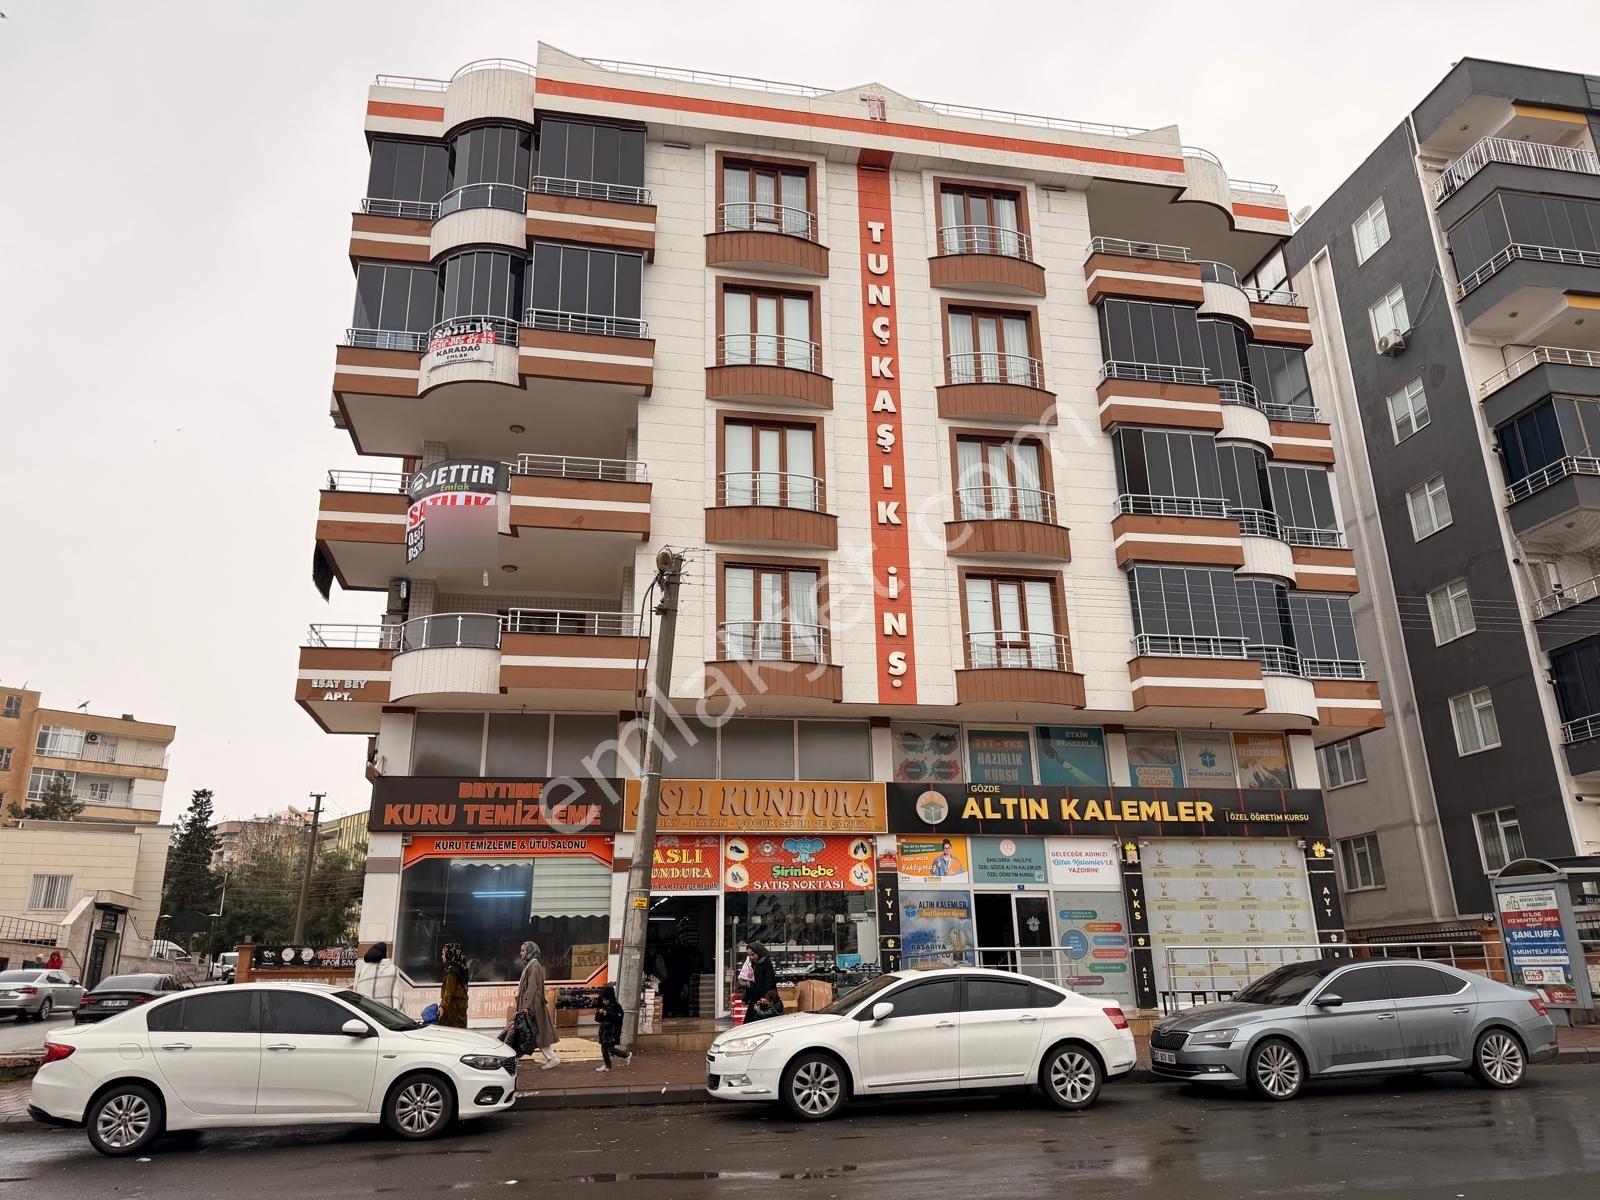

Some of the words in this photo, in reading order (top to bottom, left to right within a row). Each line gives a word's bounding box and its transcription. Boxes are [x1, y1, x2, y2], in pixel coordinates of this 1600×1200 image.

[433, 322, 494, 339] SATILIK
[436, 344, 481, 357] KARADAĞ
[867, 221, 901, 525] TUNÇKAŞIK
[440, 482, 470, 492] Emlak
[311, 679, 341, 688] ESAT
[344, 679, 368, 689] BEY
[323, 691, 353, 701] APT.
[1057, 740, 1099, 748] REHBERLİK
[977, 752, 1023, 766] HAZIRLIK
[984, 768, 1019, 781] KURSU
[971, 784, 1000, 794] GÖZDE
[631, 786, 713, 818] SLI
[720, 786, 876, 818] KUNDURA
[383, 803, 457, 826] KURU
[463, 799, 602, 826] TEMİZLEME
[961, 797, 1050, 820] ALTIN
[1060, 798, 1215, 823] KALEMLER
[1229, 812, 1249, 821] ÖZEL
[1250, 811, 1283, 821] ÖĞRETİM
[1283, 814, 1310, 822] KURSU
[690, 819, 728, 828] BAYAN
[737, 819, 776, 830] ÇOCUK
[780, 820, 809, 829] SPOR
[813, 820, 828, 829] VE
[829, 820, 867, 831] ÇANTA
[434, 840, 462, 850] KURU
[464, 839, 518, 850] TEMİZLEME
[519, 840, 527, 850] &
[529, 838, 548, 850] ÜTÜ
[550, 840, 588, 850] SALONU
[771, 864, 835, 879] Şirinbebe
[753, 881, 792, 891] SATIŞ
[792, 881, 845, 890] NOKTASI
[885, 888, 894, 921] TYT
[918, 901, 935, 909] ALTIN
[936, 901, 967, 909] KALEMLER
[1131, 888, 1142, 920] YKS
[1322, 886, 1332, 917] AYT
[1512, 930, 1560, 941] ŞANLIURFA
